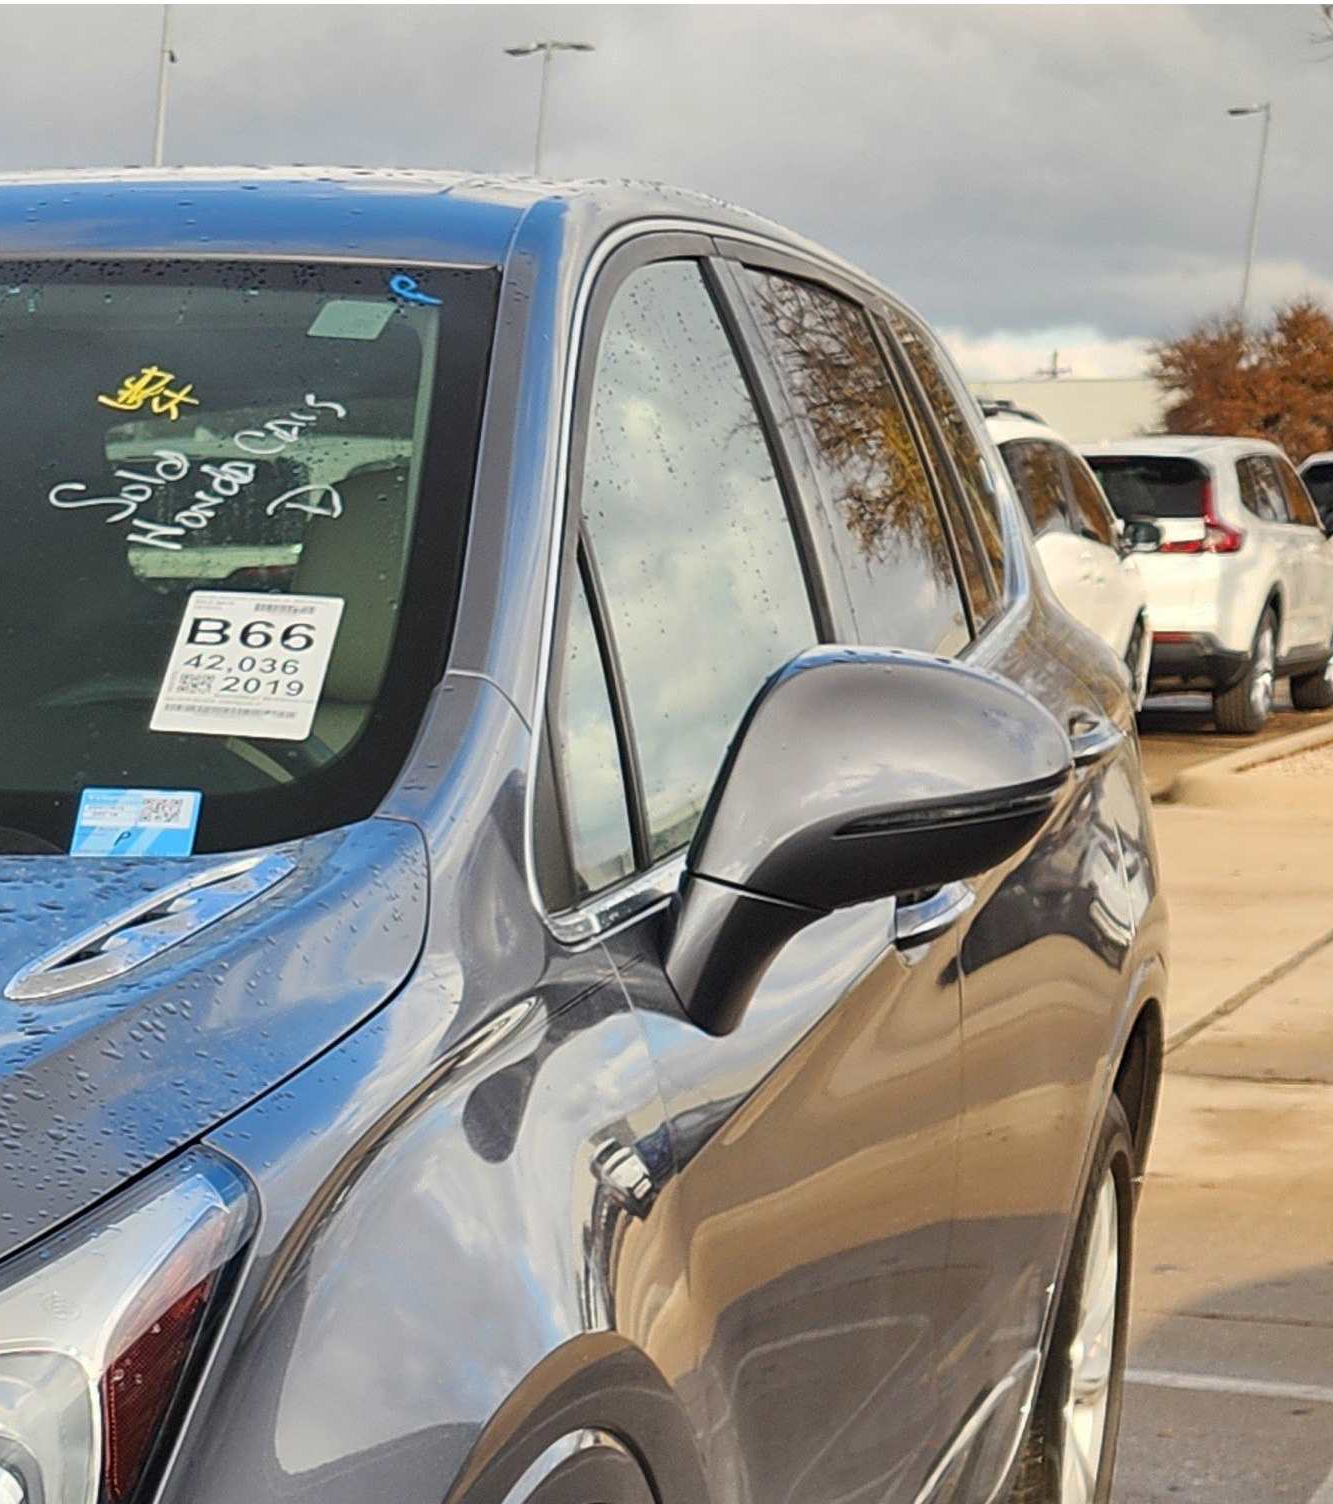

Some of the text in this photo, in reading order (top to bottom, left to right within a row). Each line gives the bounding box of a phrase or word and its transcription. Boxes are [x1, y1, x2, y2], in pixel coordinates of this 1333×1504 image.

[48, 449, 189, 524] Sold
[185, 617, 317, 652] B66
[183, 654, 300, 676] 42,036
[219, 676, 304, 697] 2019
